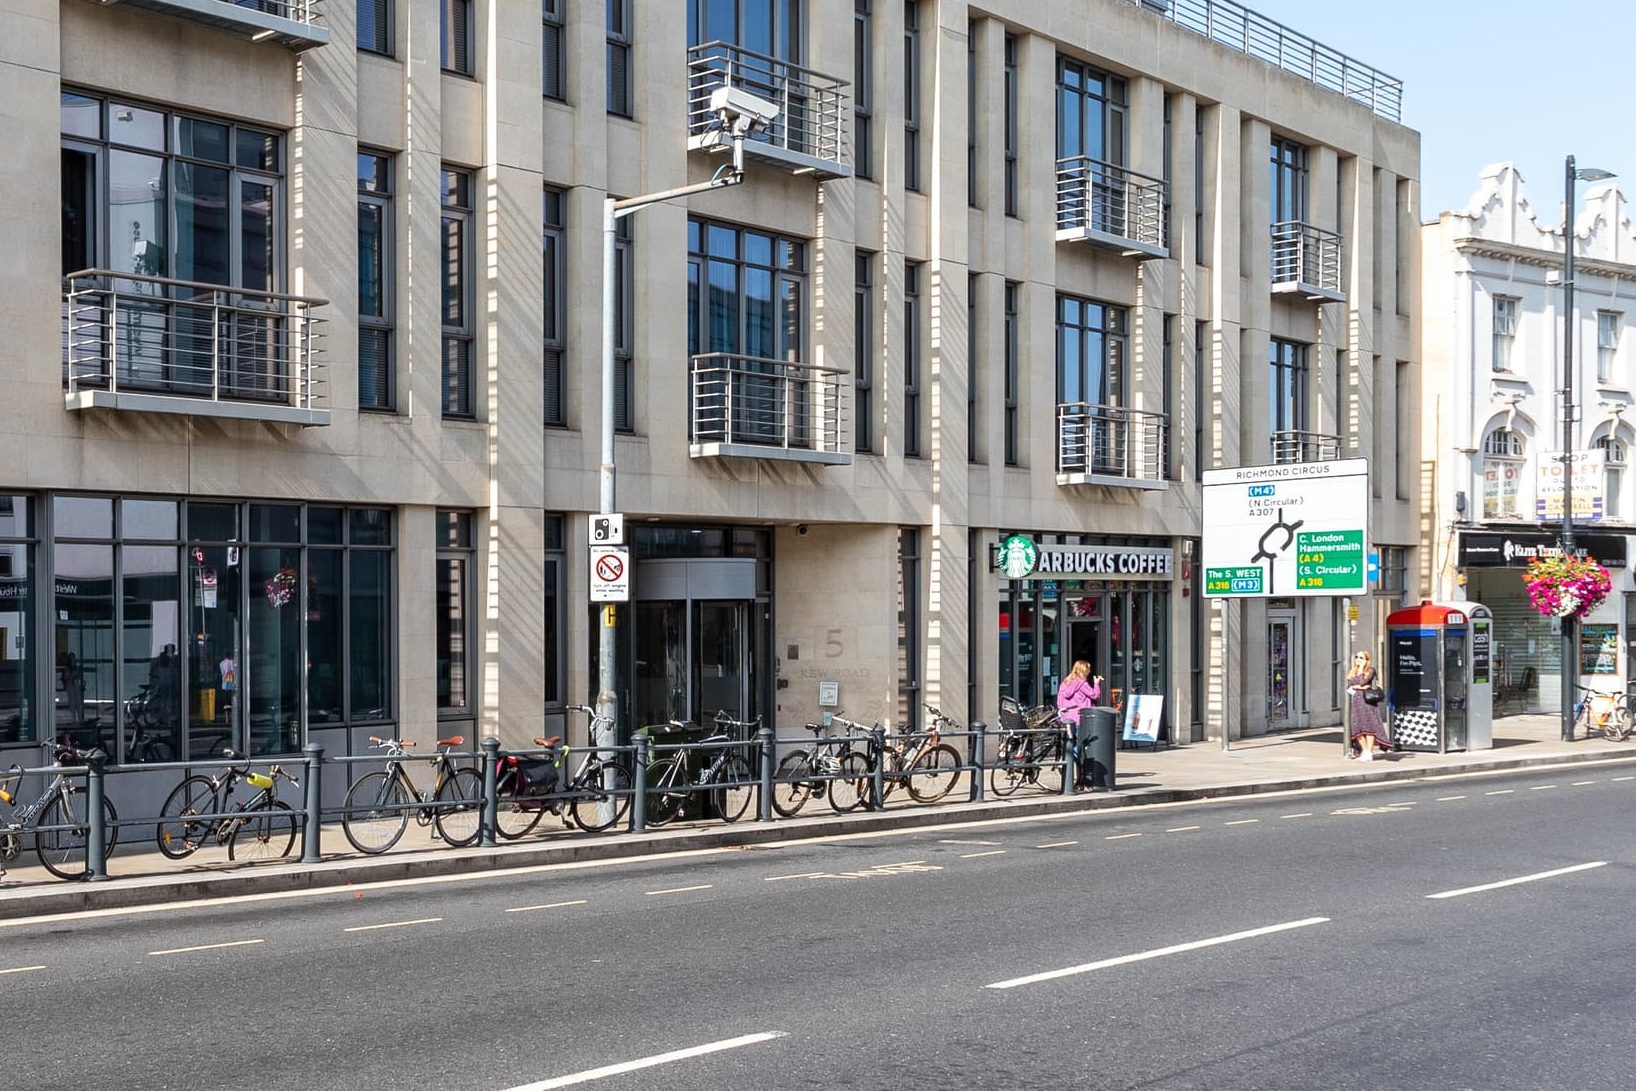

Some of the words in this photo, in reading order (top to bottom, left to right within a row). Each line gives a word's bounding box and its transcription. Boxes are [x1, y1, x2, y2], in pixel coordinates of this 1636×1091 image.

[1551, 454, 1588, 463] SOP
[1236, 468, 1289, 479] RICHMOND
[1292, 465, 1330, 476] CIRCUS
[1540, 466, 1562, 477] TO
[1299, 534, 1309, 543] C.
[1312, 534, 1345, 543] London
[1299, 543, 1361, 553] Hammersmith
[1038, 551, 1115, 574] ARBUCKS
[1119, 554, 1172, 574] COFFEE
[1208, 570, 1222, 579] The
[1224, 569, 1234, 578] S.
[1236, 568, 1261, 578] WEST
[1299, 566, 1314, 576] (S.
[1316, 565, 1357, 575] Circular)
[826, 629, 843, 658] 5
[801, 669, 827, 678] KEW
[836, 669, 868, 678] ROAD
